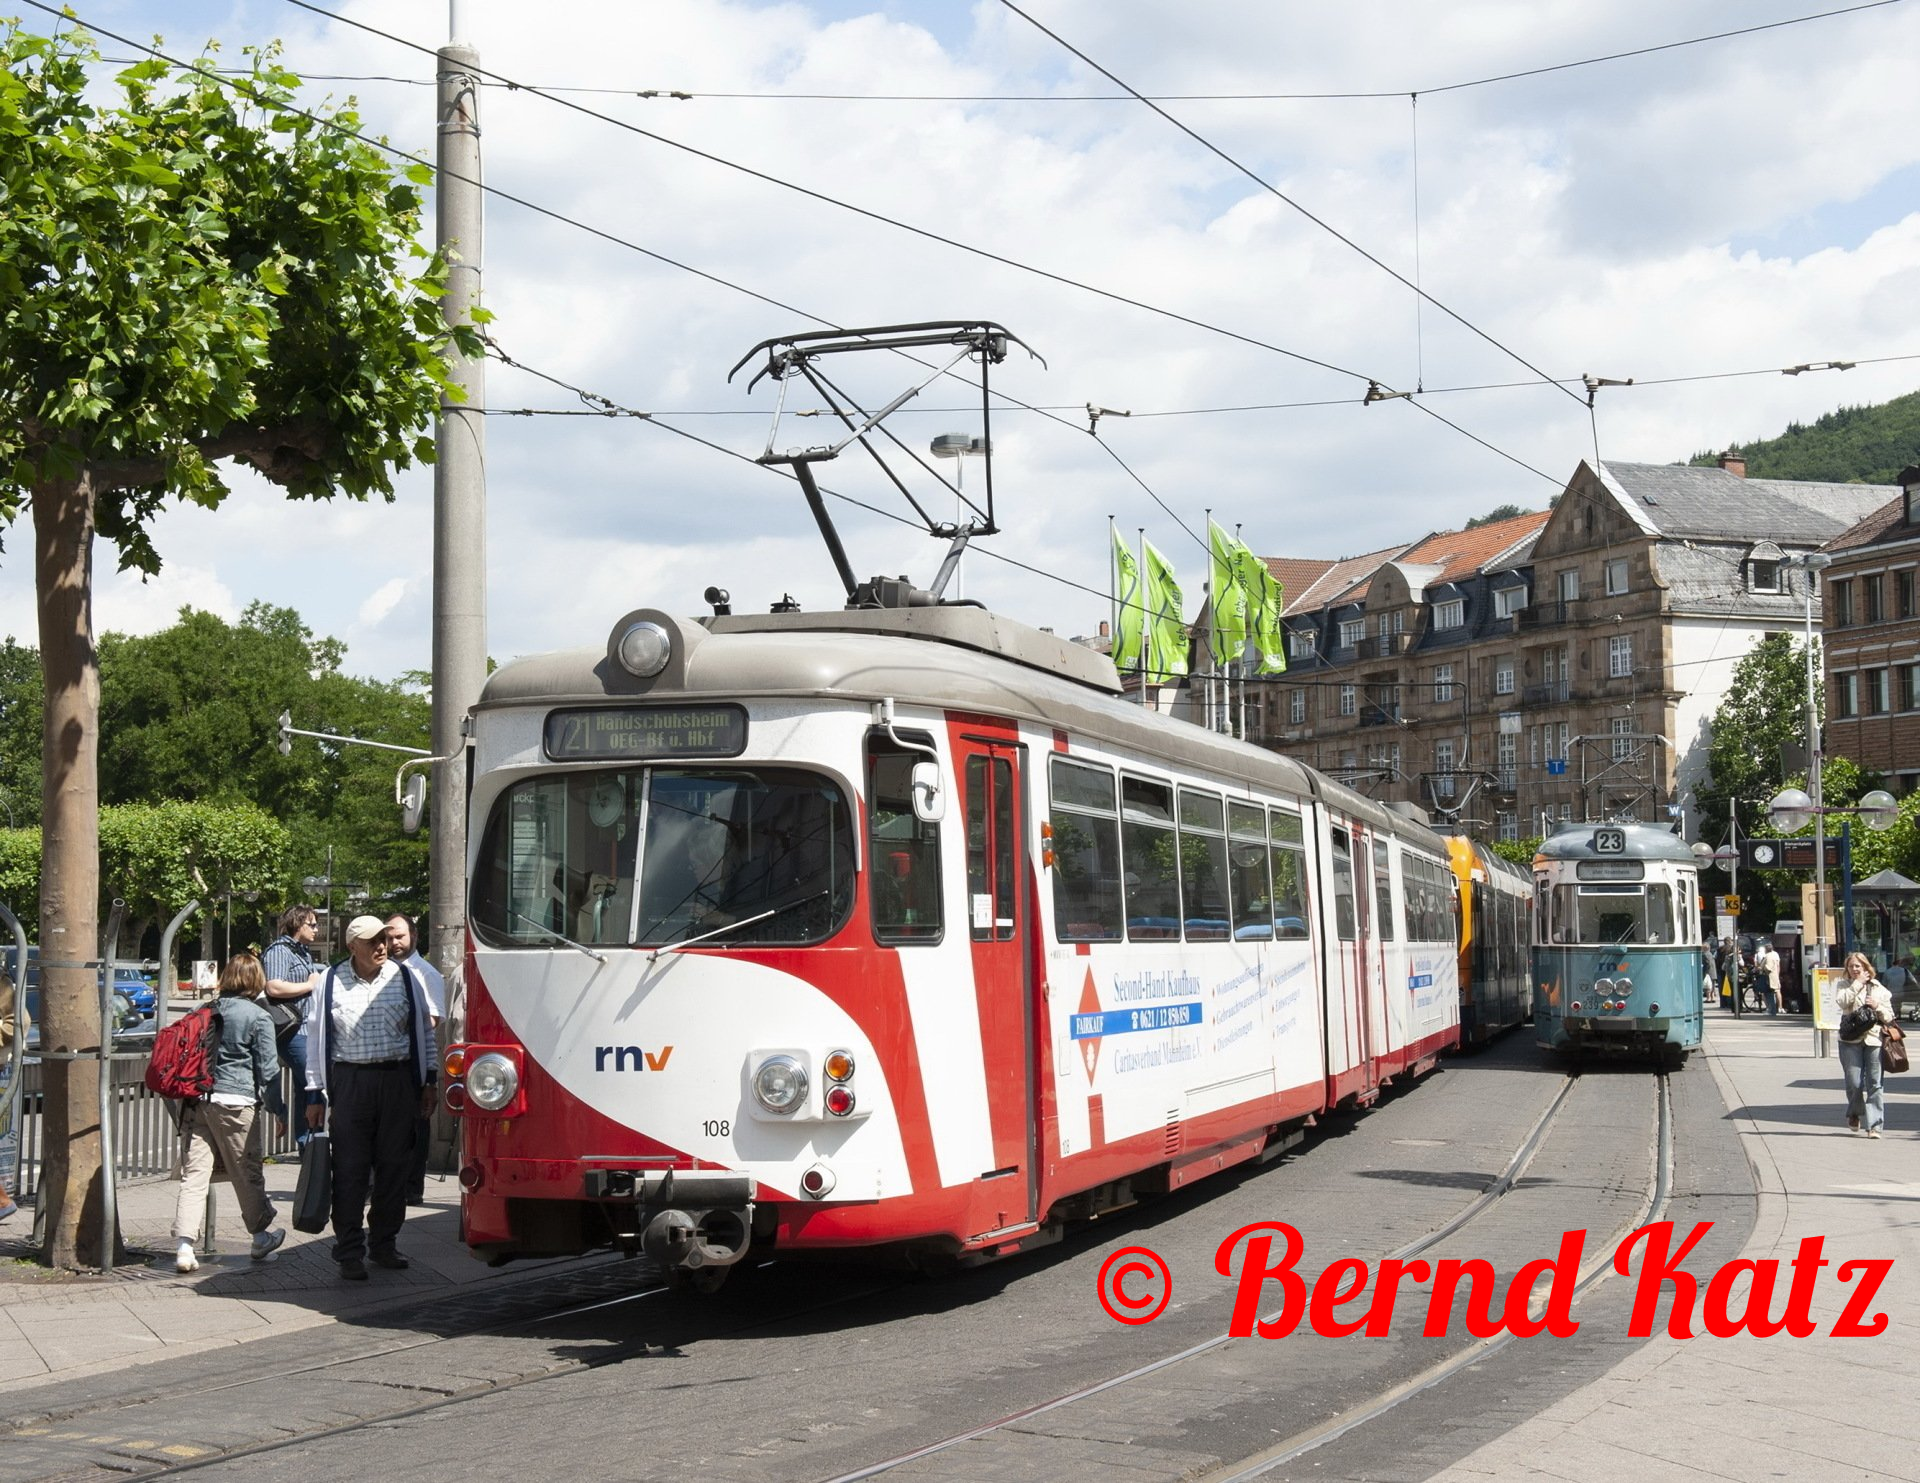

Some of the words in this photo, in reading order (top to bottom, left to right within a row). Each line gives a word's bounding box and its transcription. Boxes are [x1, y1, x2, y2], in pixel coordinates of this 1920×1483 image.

[564, 715, 591, 750] 21
[596, 712, 730, 731] Handschuhsheim
[609, 731, 665, 749] OEG-Bf
[669, 732, 683, 747] ü.
[687, 730, 715, 746] Hbf
[1552, 761, 1561, 773] T
[1669, 806, 1680, 815] W
[1600, 833, 1622, 849] 23
[1725, 899, 1739, 910] K5
[1599, 962, 1630, 972] rnv
[1113, 971, 1166, 1002] Second-Hand
[1167, 968, 1201, 998] Kaufhaus
[595, 1045, 674, 1072] rnv
[1114, 1044, 1162, 1075] Caritasverband
[702, 1119, 730, 1137] 108
